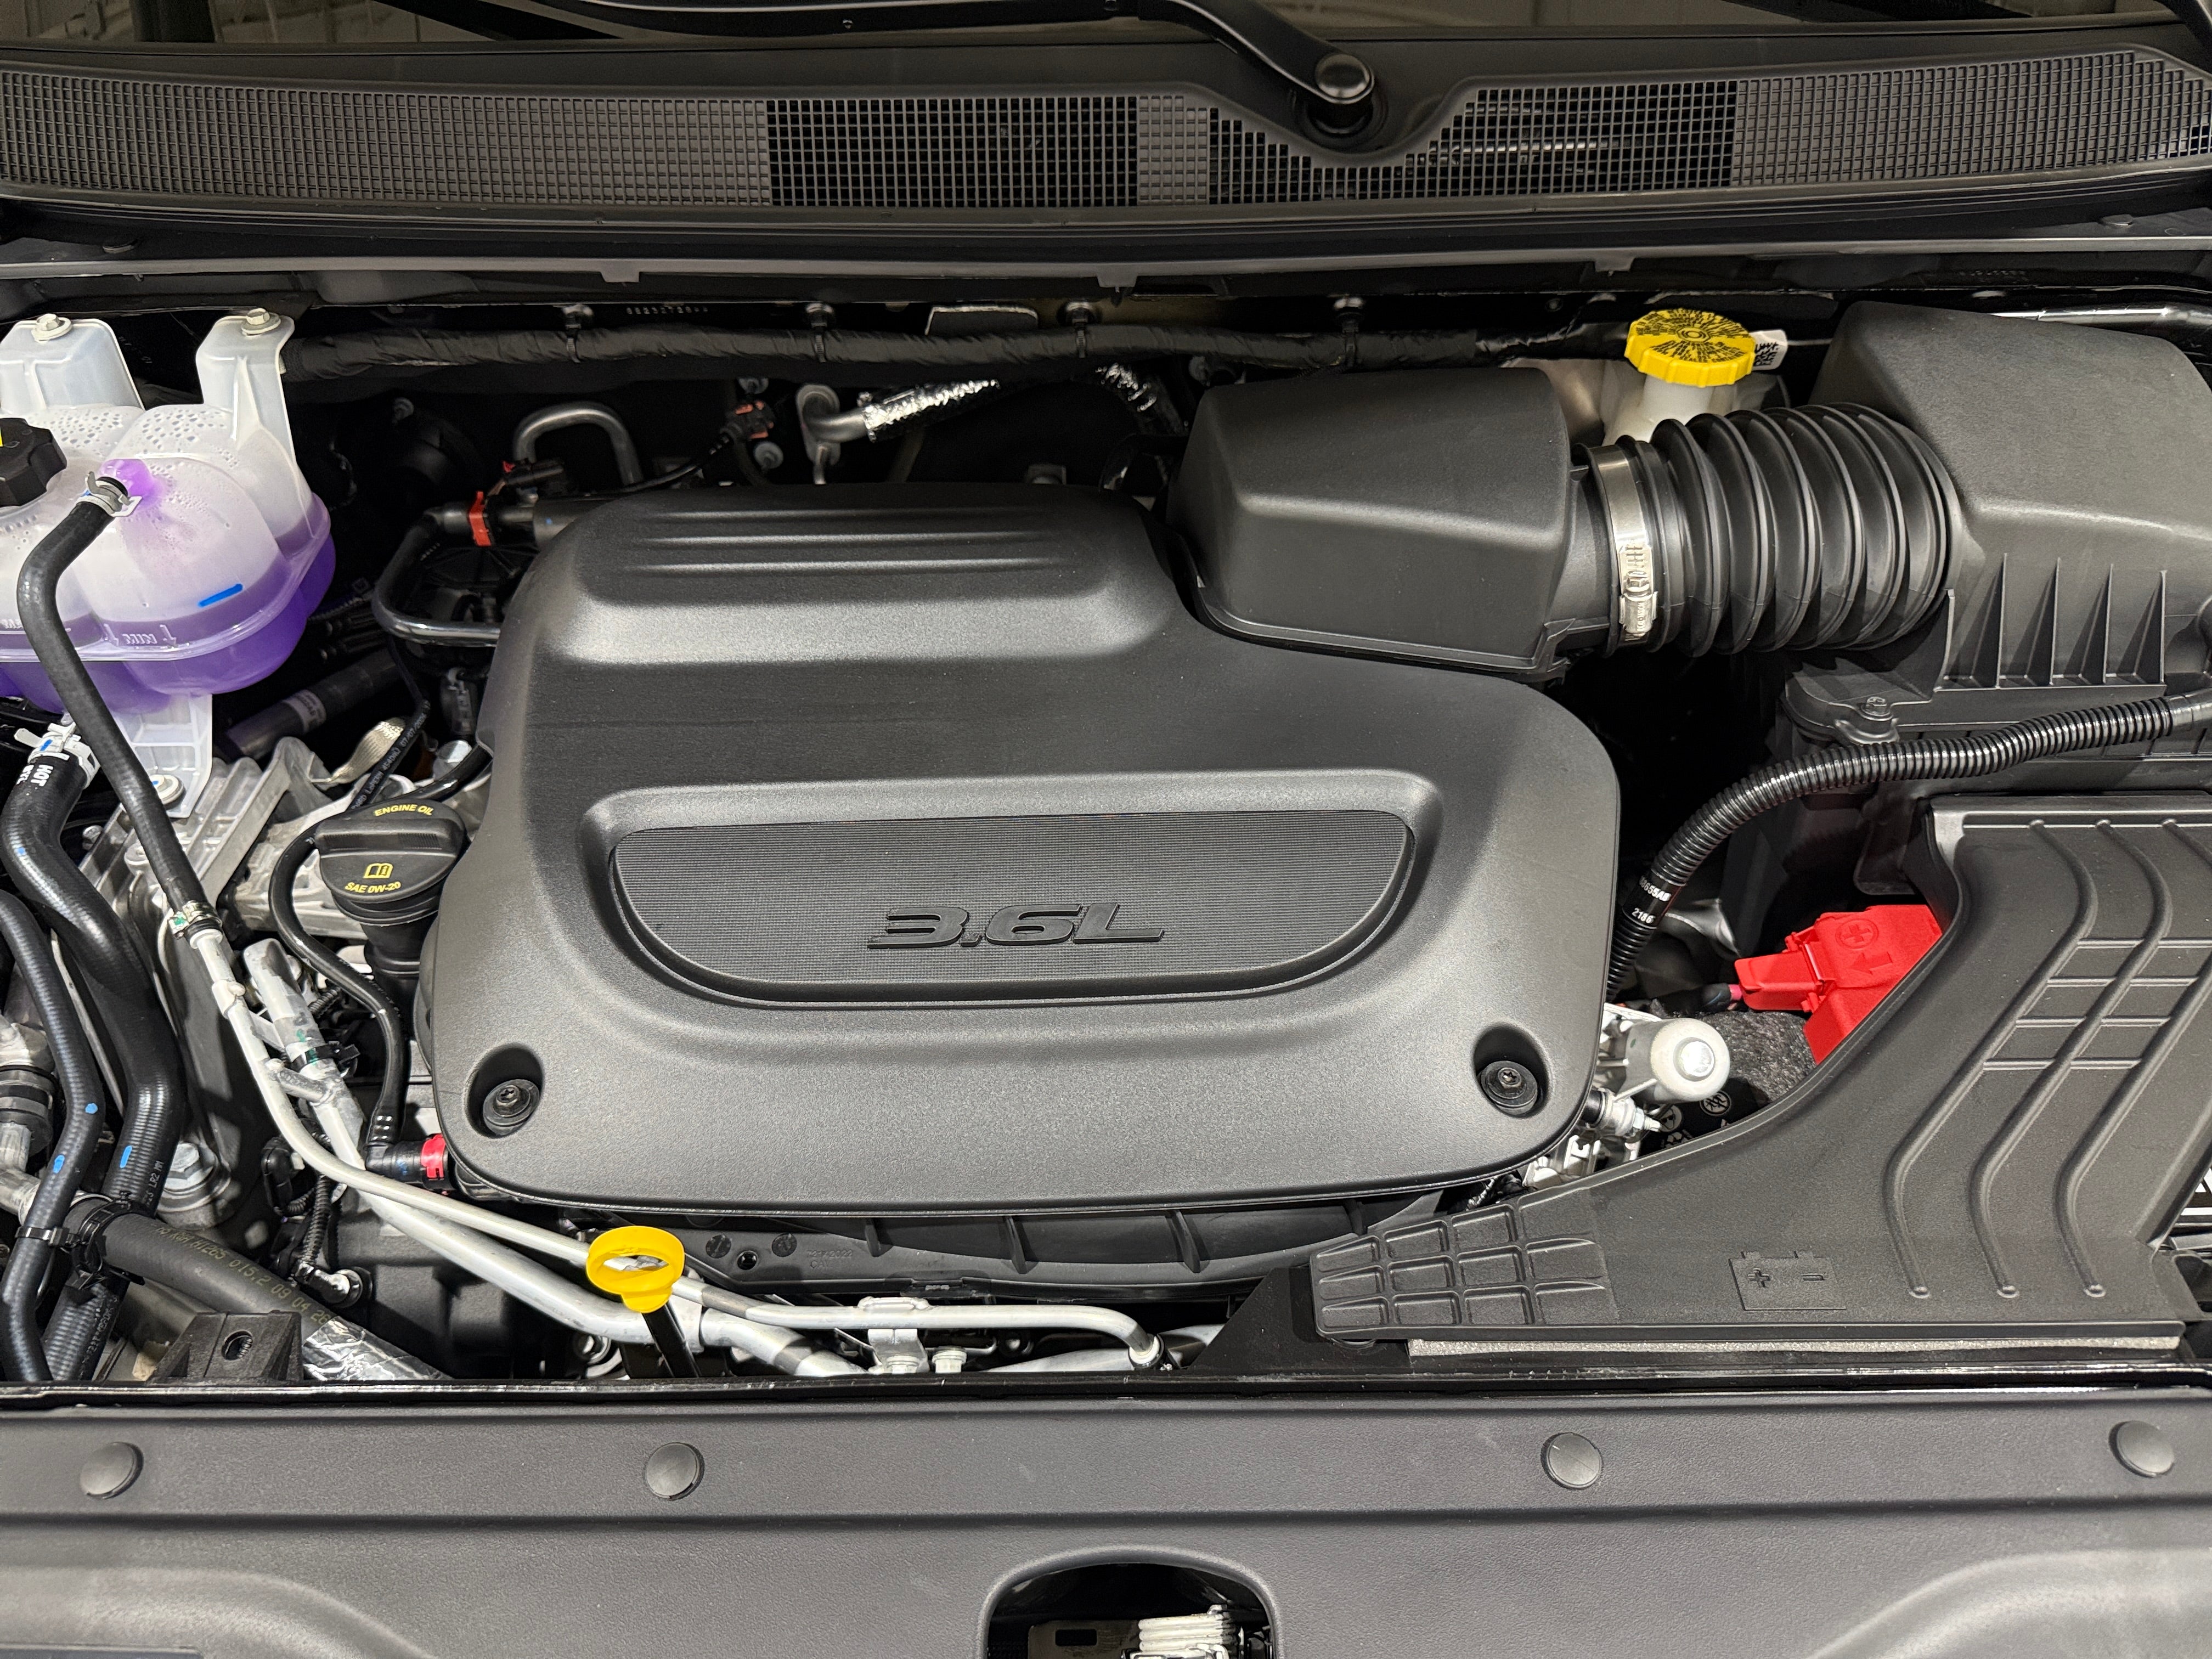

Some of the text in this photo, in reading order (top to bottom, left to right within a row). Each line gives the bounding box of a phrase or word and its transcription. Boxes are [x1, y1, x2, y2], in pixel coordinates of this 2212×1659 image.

[122, 634, 157, 644] MIN
[30, 764, 54, 787] HOT
[375, 804, 434, 816] ENGINE OIL
[345, 882, 402, 893] SAE 0W-20
[1632, 907, 1656, 924] 2186
[867, 902, 1164, 949] 3.6L
[272, 1283, 292, 1300] 09
[291, 1297, 312, 1312] 04
